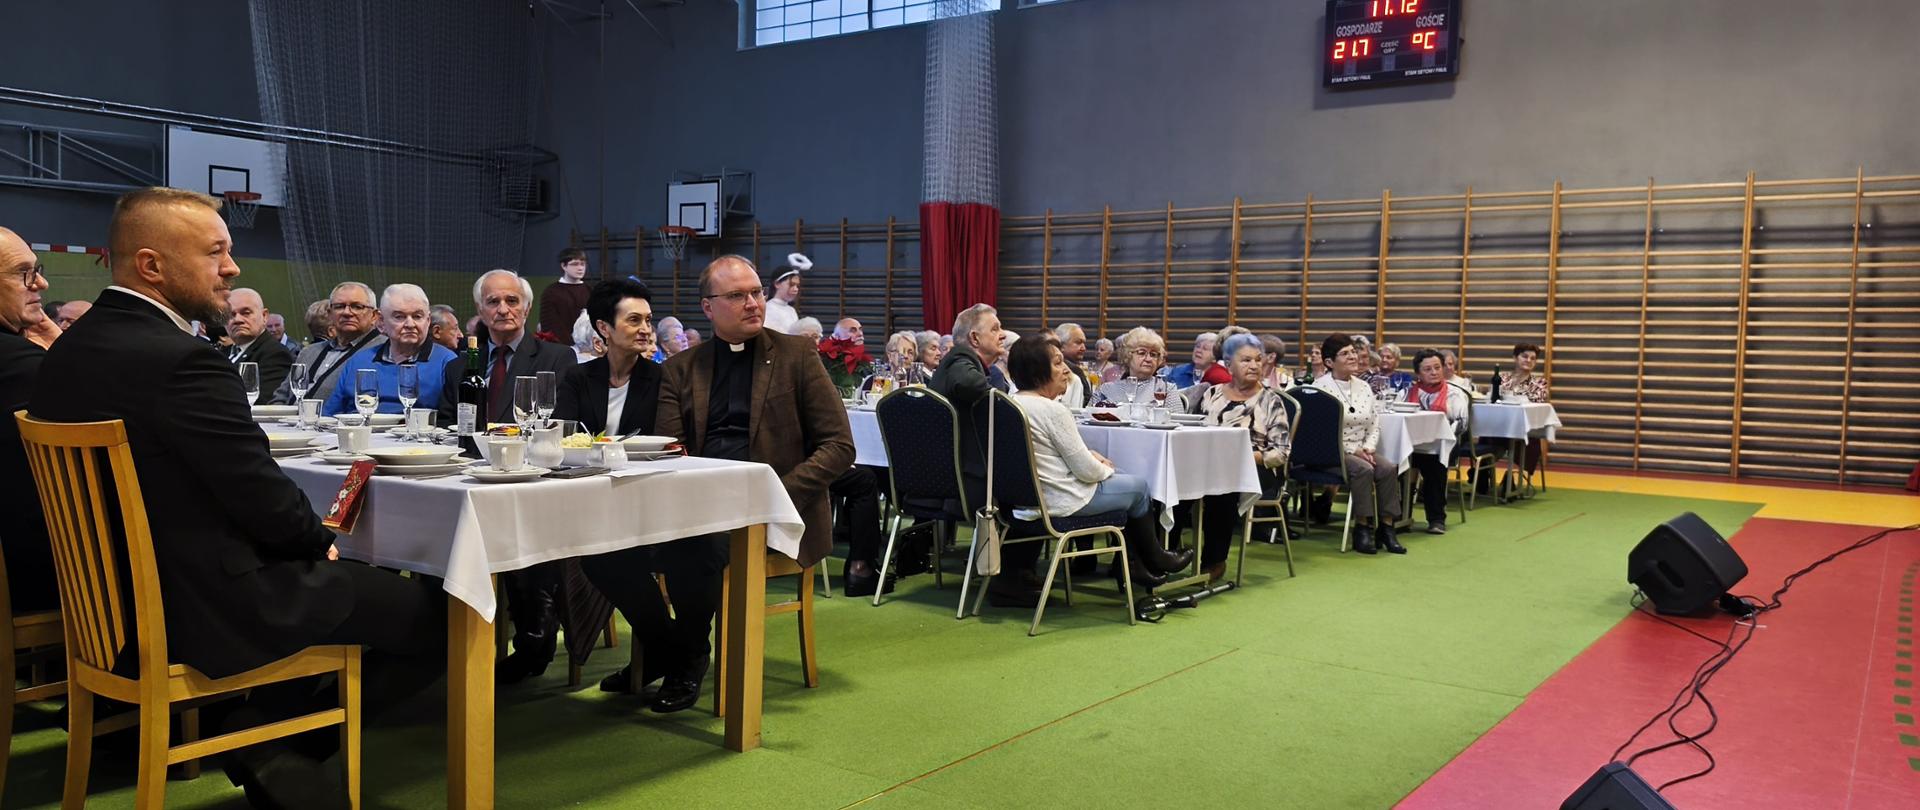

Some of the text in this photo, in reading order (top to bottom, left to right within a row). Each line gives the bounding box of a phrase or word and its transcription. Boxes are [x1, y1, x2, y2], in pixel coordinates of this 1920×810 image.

[1415, 12, 1445, 28] GOŚCIE
[1336, 21, 1383, 37] GOSPODARZE
[1333, 39, 1368, 59] 21.7
